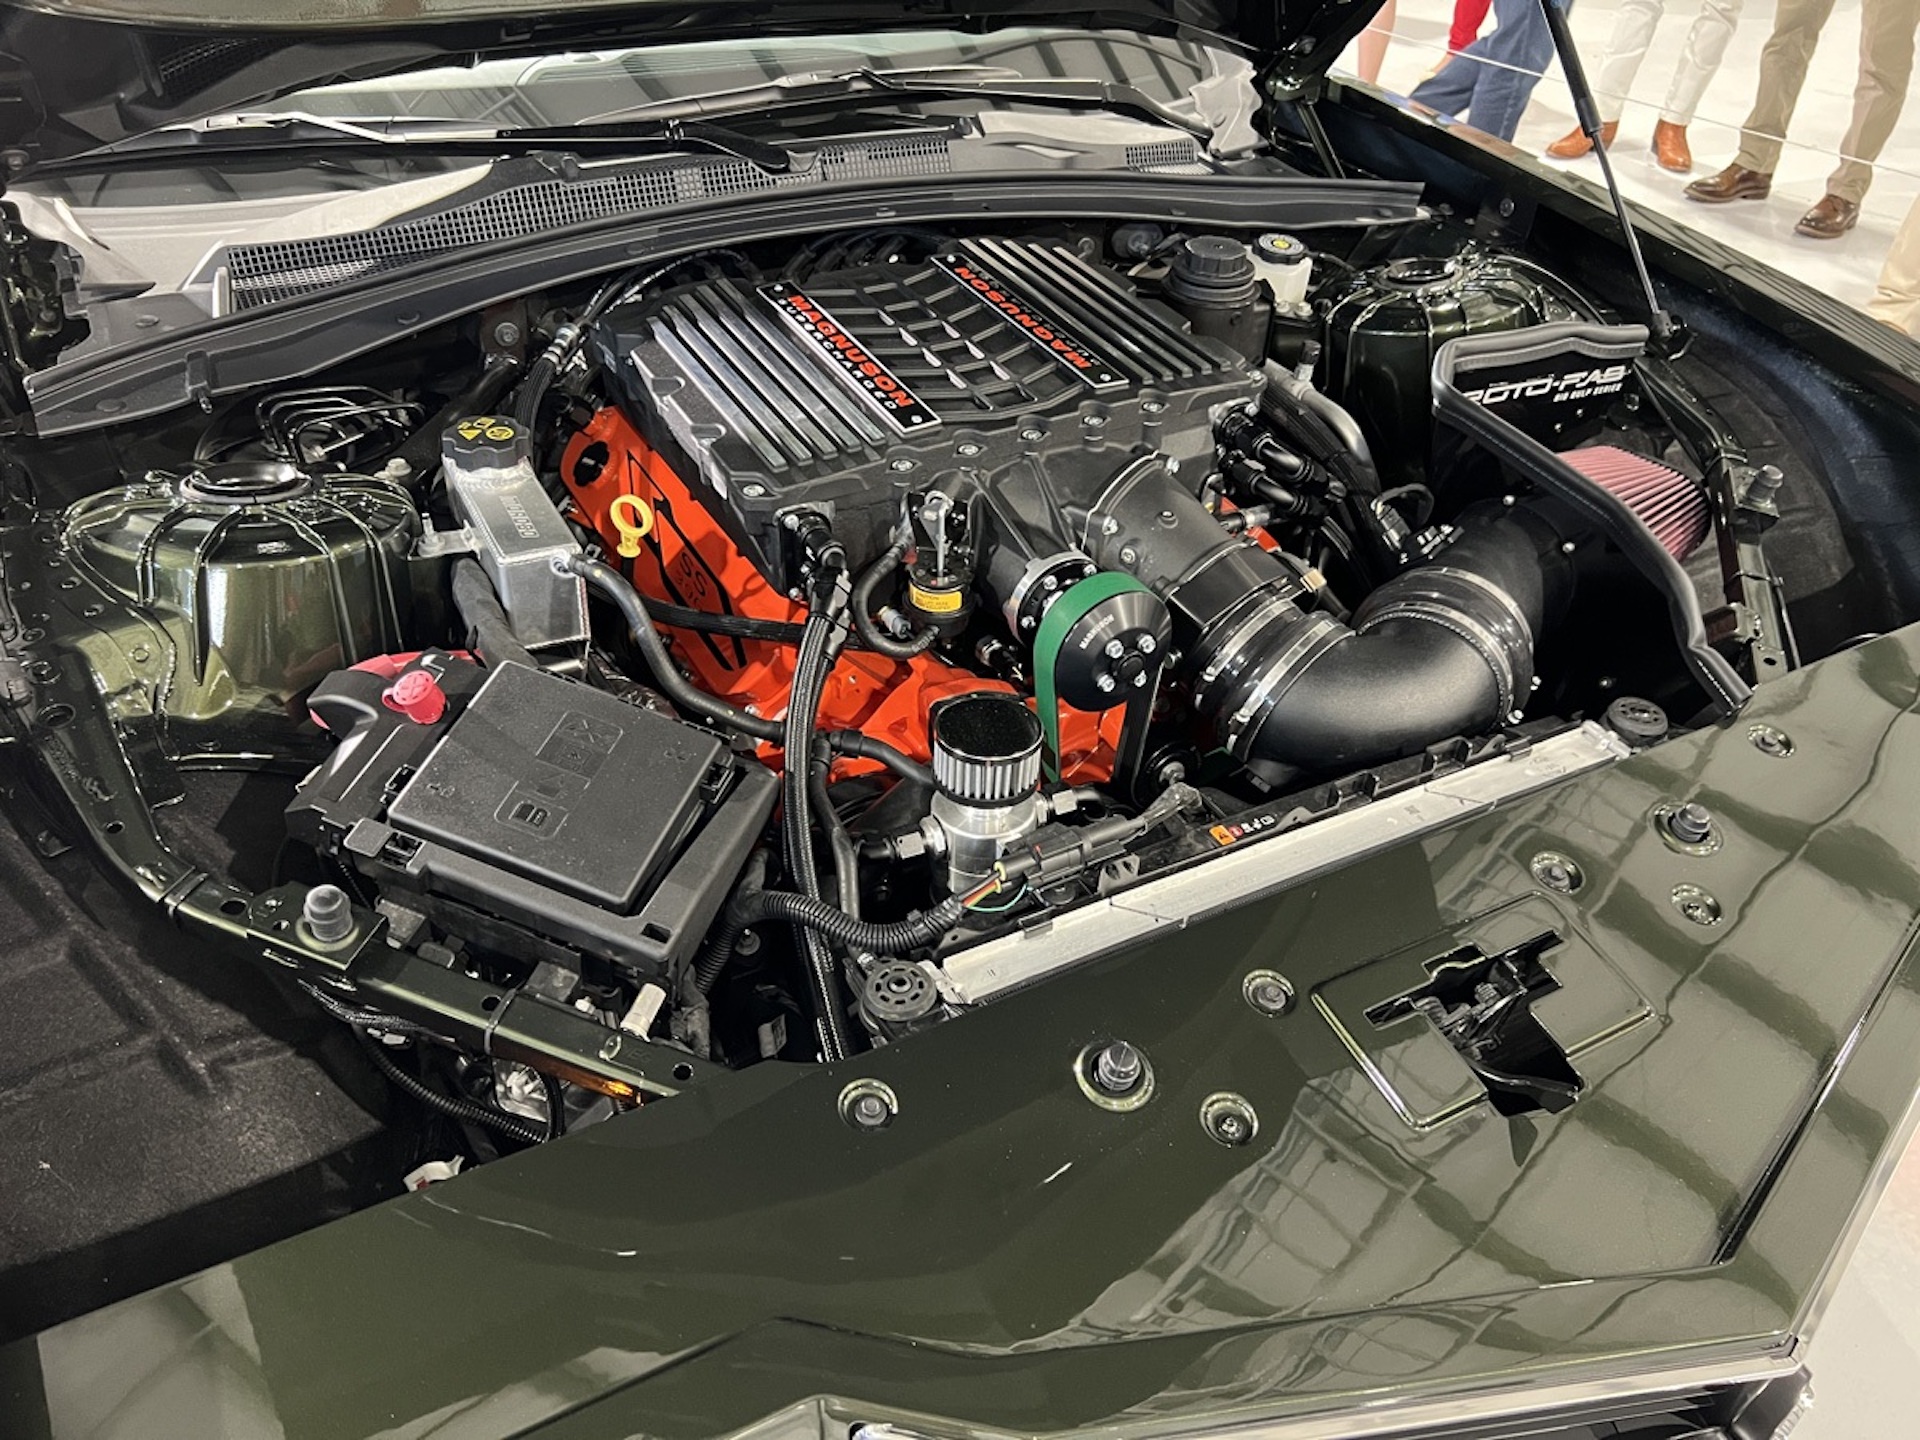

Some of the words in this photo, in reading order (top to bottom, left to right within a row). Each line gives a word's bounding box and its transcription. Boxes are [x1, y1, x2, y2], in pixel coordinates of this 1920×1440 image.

[777, 299, 898, 410] SUPERCHARGED
[787, 295, 915, 408] MAGNUSON
[954, 266, 1093, 369] MAGNUSON
